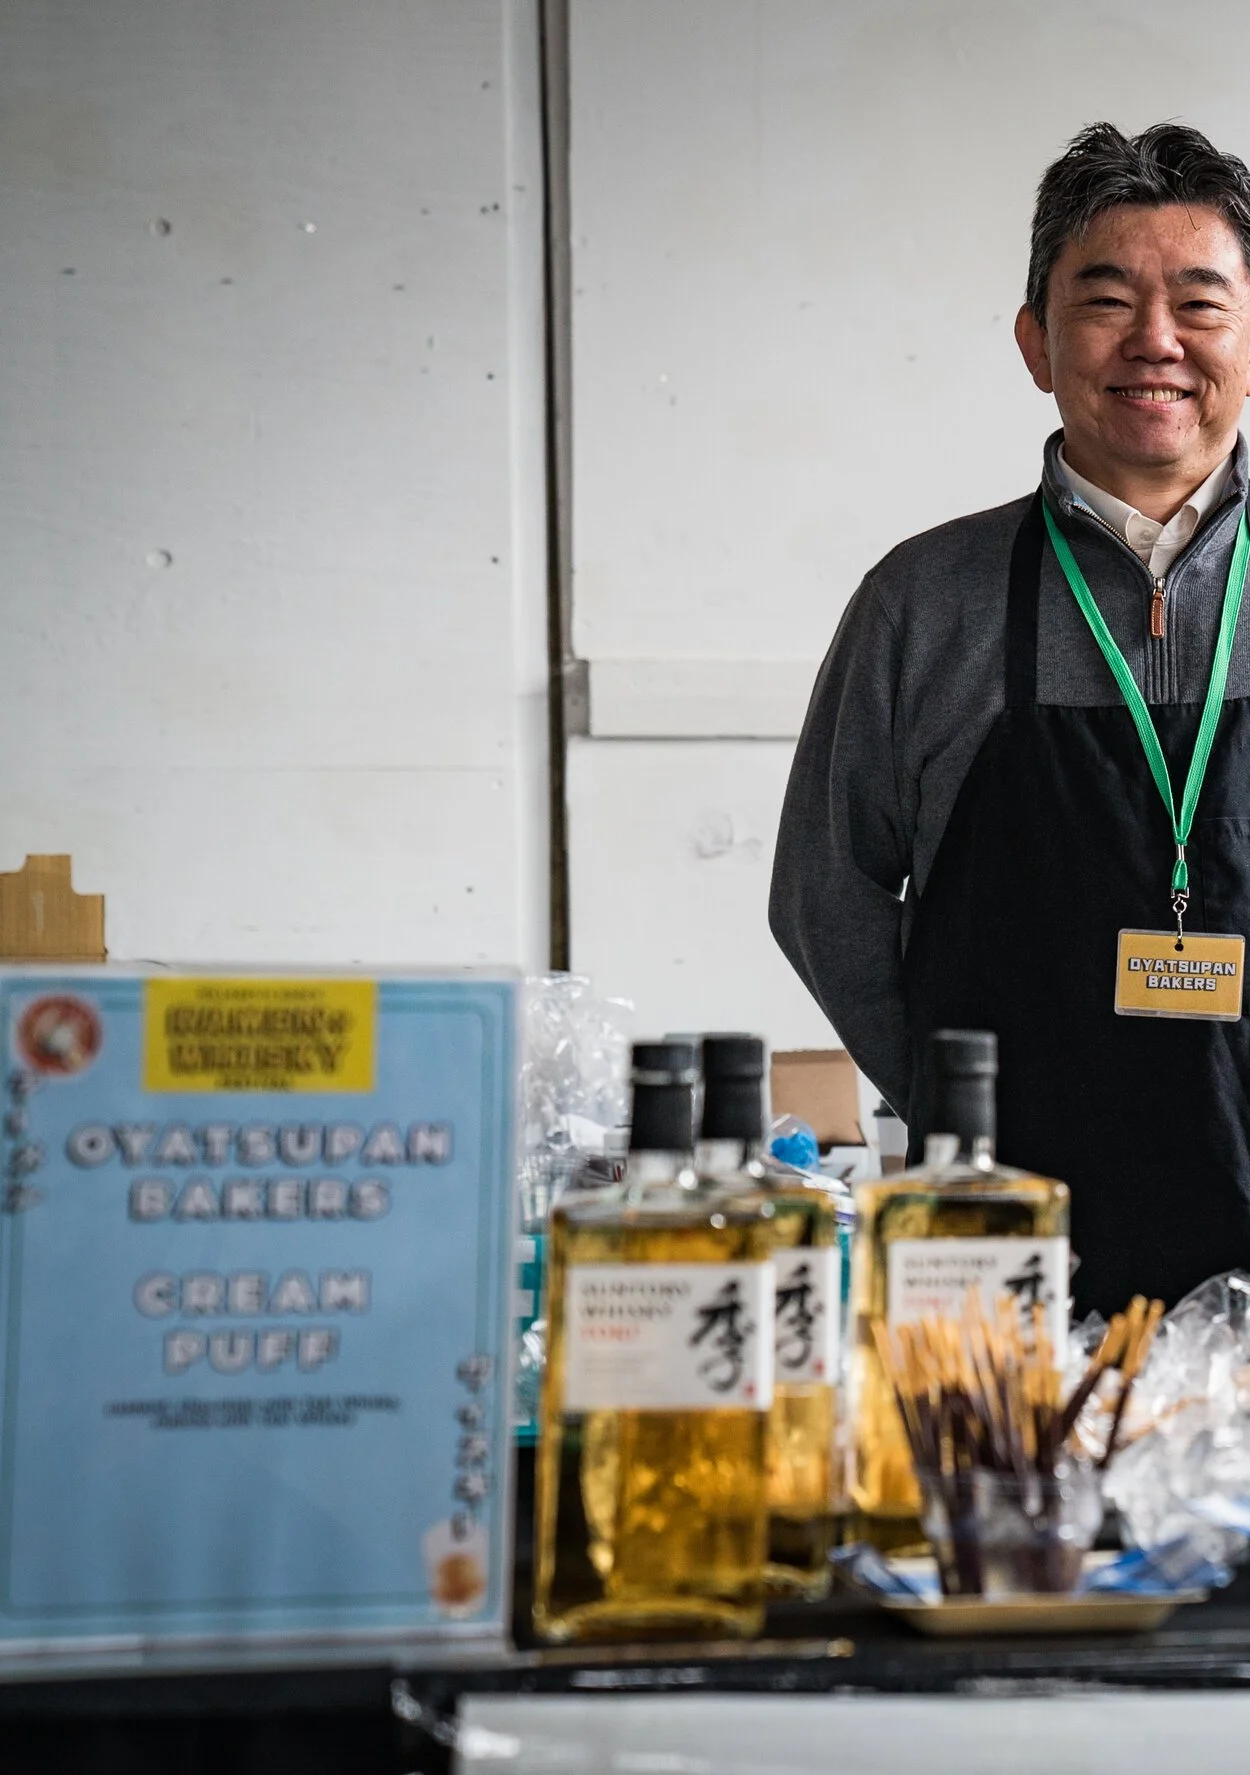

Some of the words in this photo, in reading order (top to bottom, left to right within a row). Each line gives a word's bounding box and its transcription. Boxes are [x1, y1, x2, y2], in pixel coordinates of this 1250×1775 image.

[1128, 957, 1237, 976] OYATSUPAN
[1146, 975, 1217, 991] BAKERS
[66, 1121, 455, 1167] OYATSUPAN
[128, 1177, 392, 1223] BAKERS
[134, 1271, 371, 1317] CREAM
[164, 1327, 339, 1376] PUFF
